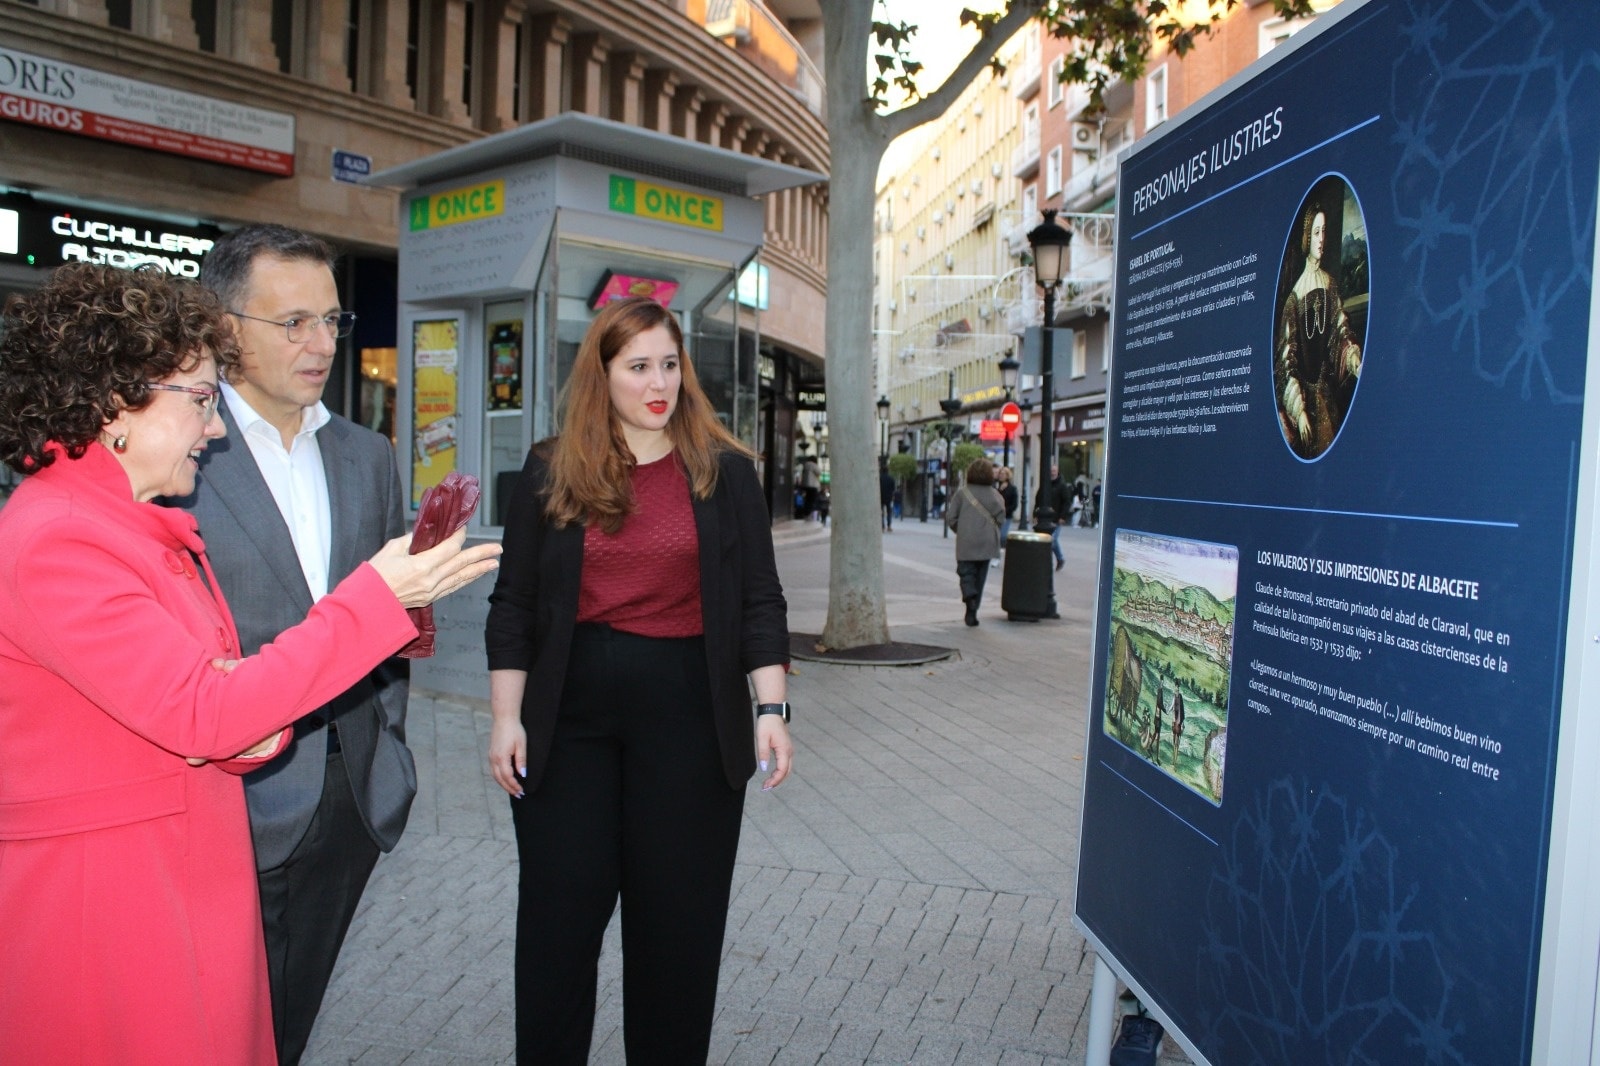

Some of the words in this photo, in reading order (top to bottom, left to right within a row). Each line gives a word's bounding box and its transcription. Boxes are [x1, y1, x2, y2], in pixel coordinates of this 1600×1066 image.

[0, 95, 84, 131] GUROS
[1133, 150, 1206, 216] PERSONAJES
[1210, 106, 1283, 174] ILUSTRES
[436, 185, 496, 221] ONCE
[644, 187, 715, 225] ONCE
[1130, 256, 1143, 270] ISABEL
[1144, 252, 1150, 264] DE
[1207, 261, 1232, 277] matrimonio
[1233, 259, 1241, 269] con
[1242, 253, 1257, 265] Carlos
[1192, 307, 1201, 316] casa
[1203, 302, 1215, 312] varias
[1216, 296, 1236, 309] ciudades
[1241, 290, 1255, 301] villas,
[1196, 288, 1209, 298] enlace
[1210, 276, 1236, 293] matrimonial
[1237, 273, 1256, 288] pasaron
[1164, 375, 1181, 389] personal
[1185, 375, 1201, 383] cercana.
[1202, 371, 1215, 381] Como
[1215, 368, 1231, 379] señora
[1232, 363, 1251, 376] nombró
[1178, 360, 1187, 371] pero
[1192, 351, 1224, 366] documentación
[1225, 346, 1252, 359] conservada
[1190, 390, 1209, 399] intereses
[1221, 384, 1242, 395] derechos
[1216, 403, 1248, 414] sobrevivieron
[1258, 551, 1271, 565] LOS
[1273, 553, 1308, 571] VIAJEROS
[1310, 558, 1315, 572] Y
[1316, 560, 1332, 575] SUS
[1335, 562, 1399, 587] IMPRESIONES
[1402, 572, 1416, 589] DE
[1418, 575, 1479, 600] ALBACETE
[1256, 582, 1273, 595] Claude
[1275, 585, 1282, 597] de
[1283, 587, 1313, 606] Bronseval,
[1315, 596, 1349, 611] secretario
[1351, 602, 1378, 618] privado
[1381, 607, 1393, 621] del
[1395, 610, 1415, 625] abad
[1418, 614, 1429, 629] de
[1432, 617, 1470, 640] Claraval,
[1474, 628, 1493, 644] que
[1497, 633, 1510, 646] en
[1253, 620, 1278, 636] Península
[1280, 627, 1299, 642] Ibérica
[1301, 635, 1308, 645] en
[1310, 638, 1323, 650] 1532
[1324, 642, 1328, 653] y
[1330, 643, 1344, 658] 1533
[1346, 645, 1361, 661] dijo:
[1254, 602, 1273, 615] calidad
[1274, 605, 1281, 617] de
[1291, 609, 1297, 621] lo
[1298, 614, 1331, 629] acompañó
[1332, 622, 1341, 632] en
[1342, 624, 1354, 635] sus
[1356, 625, 1376, 642] viajes
[1378, 633, 1382, 642] a
[1384, 630, 1395, 645] las
[1397, 637, 1419, 651] casas
[1421, 640, 1480, 666] cistercienses
[1483, 654, 1496, 670] de
[1499, 656, 1507, 673] la
[1283, 672, 1290, 681] un
[1291, 672, 1317, 691] hermoso
[1318, 684, 1322, 695] y
[1323, 685, 1337, 701] muy
[1338, 687, 1355, 704] buen
[1356, 697, 1382, 713] pueblo
[1401, 709, 1414, 724] allí
[1415, 712, 1452, 737] bebimos
[1454, 725, 1477, 746] buen
[1480, 735, 1501, 753] vino
[1270, 688, 1280, 698] una
[1281, 692, 1290, 702] vez
[1292, 696, 1317, 715] apurado,
[1320, 707, 1356, 727] avanzamos
[1358, 719, 1387, 739] siempre
[1388, 732, 1403, 744] por
[1405, 737, 1415, 750] un
[1418, 742, 1449, 762] camino
[1451, 754, 1470, 769] real
[1472, 762, 1499, 780] entre
